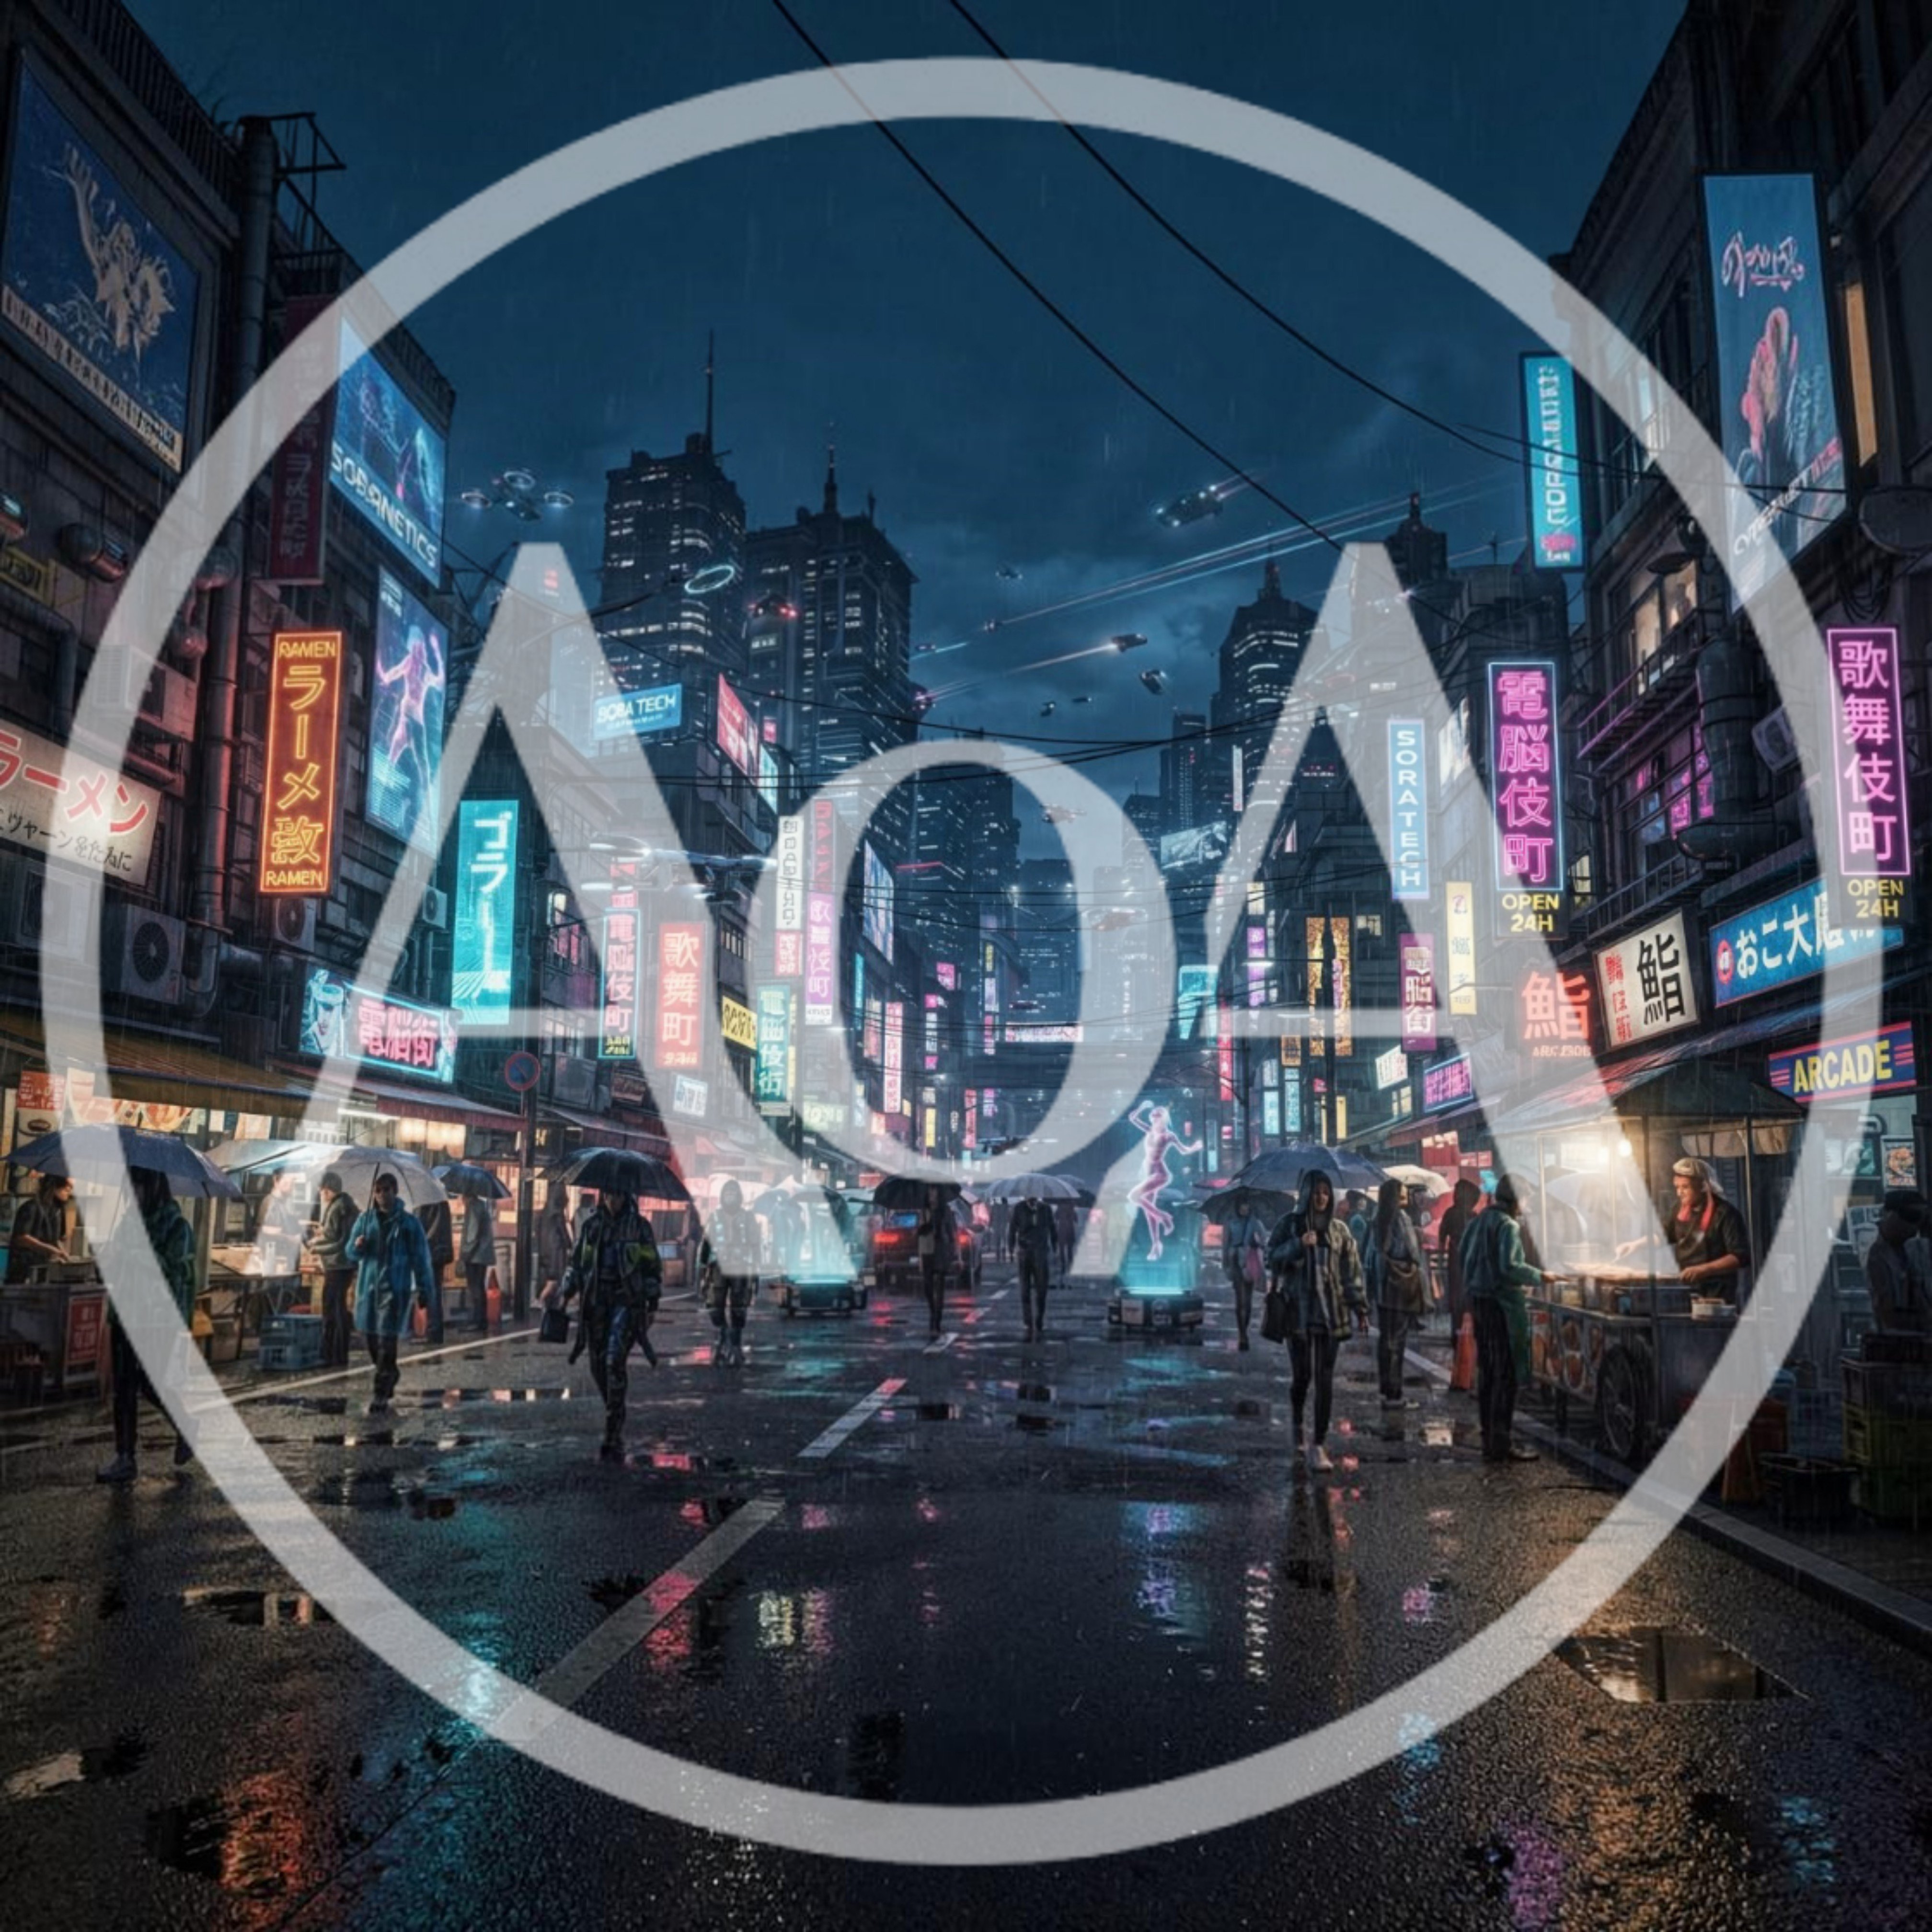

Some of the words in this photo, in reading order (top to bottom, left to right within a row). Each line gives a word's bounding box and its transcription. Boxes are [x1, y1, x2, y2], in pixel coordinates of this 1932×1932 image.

[278, 641, 336, 658] RAMEN
[1838, 640, 1898, 861] 歌舞伎町
[0, 729, 149, 836] ラーメン
[264, 870, 323, 886] RAMEN
[1847, 879, 1904, 897] OPEN
[1502, 893, 1559, 910] OPEN
[1856, 899, 1898, 919] 24H
[1510, 913, 1553, 932] 24H
[662, 931, 700, 1046] 歌舞町
[1637, 933, 1686, 1025] 鮨
[1521, 971, 1591, 1040] 鮨
[1794, 1040, 1892, 1092] ARCADE
